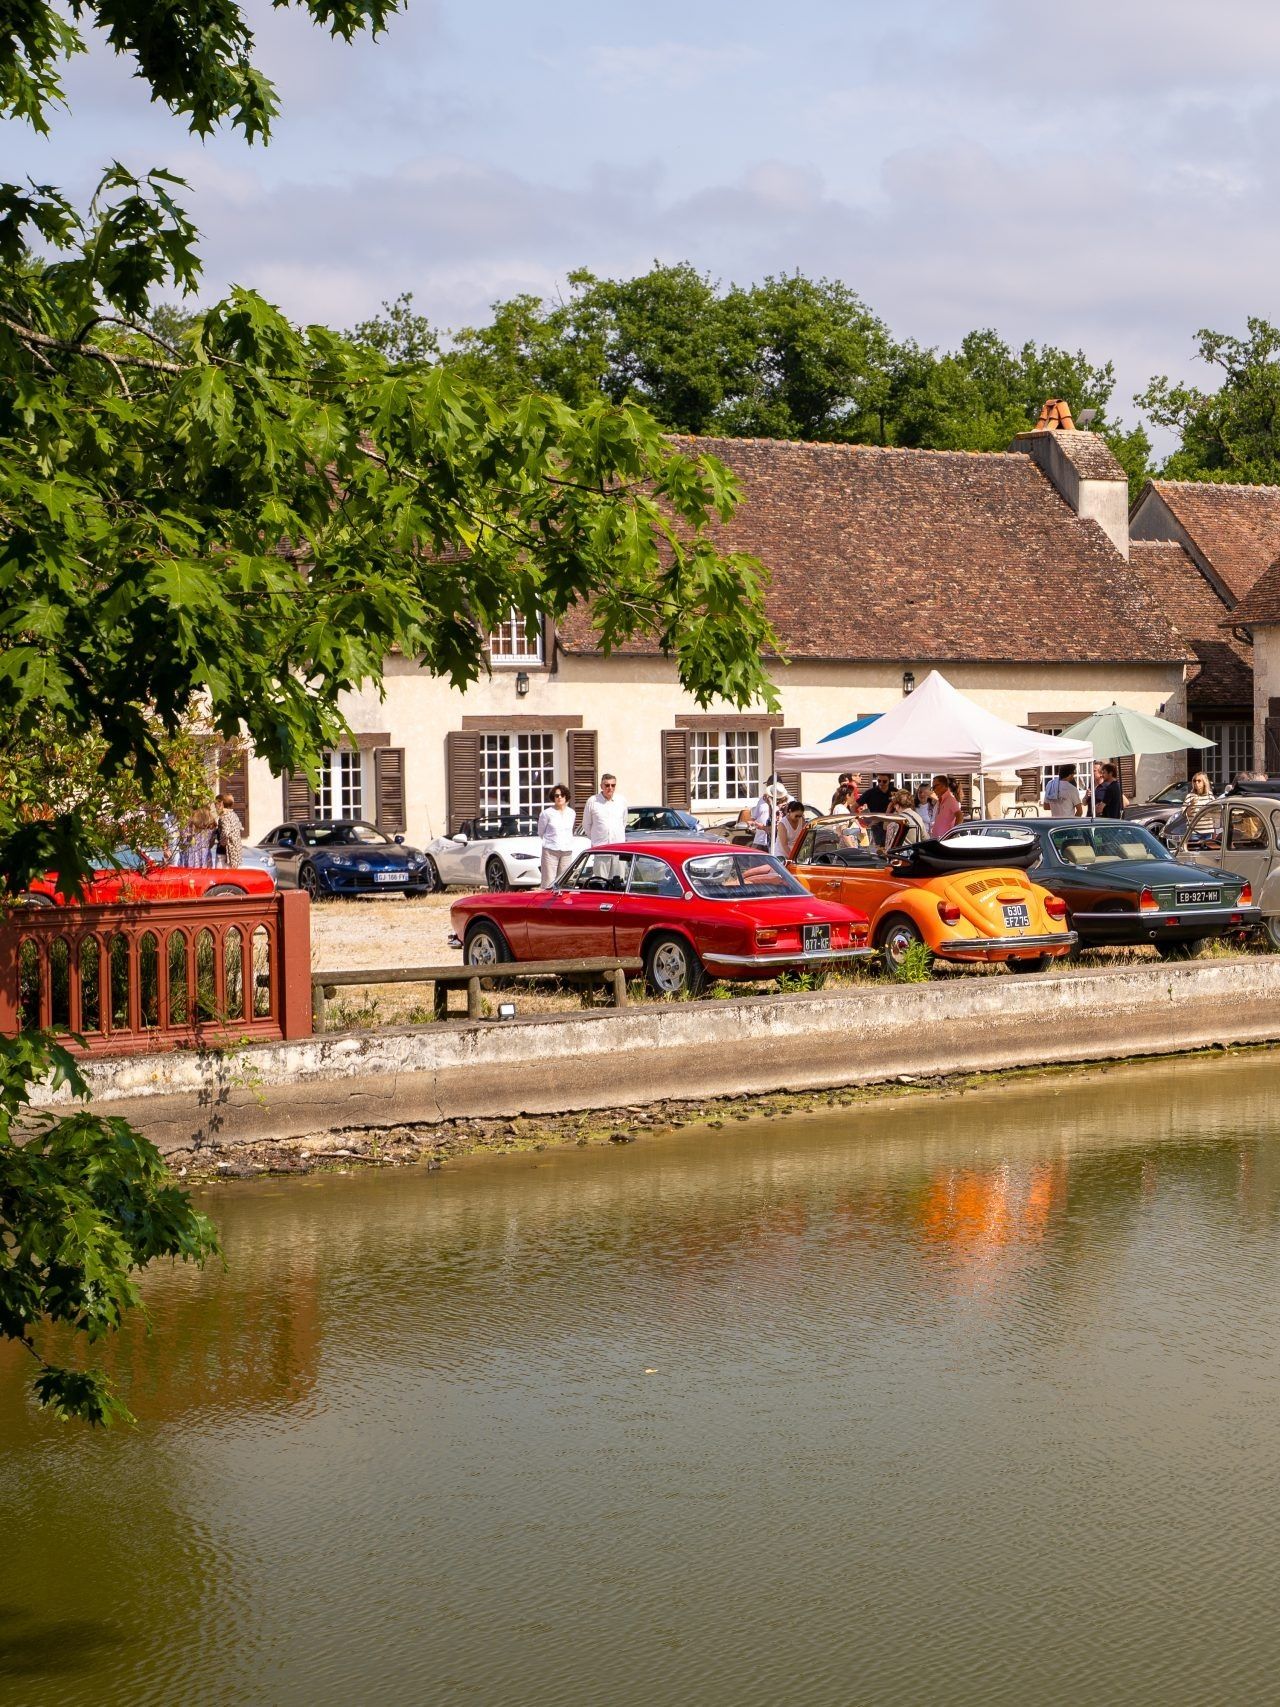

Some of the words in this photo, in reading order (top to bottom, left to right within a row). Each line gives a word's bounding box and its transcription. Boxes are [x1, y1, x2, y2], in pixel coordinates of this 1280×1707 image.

[1180, 892, 1218, 902] EB-927-WH
[1007, 906, 1022, 916] 630
[805, 938, 829, 950] 877-KF
